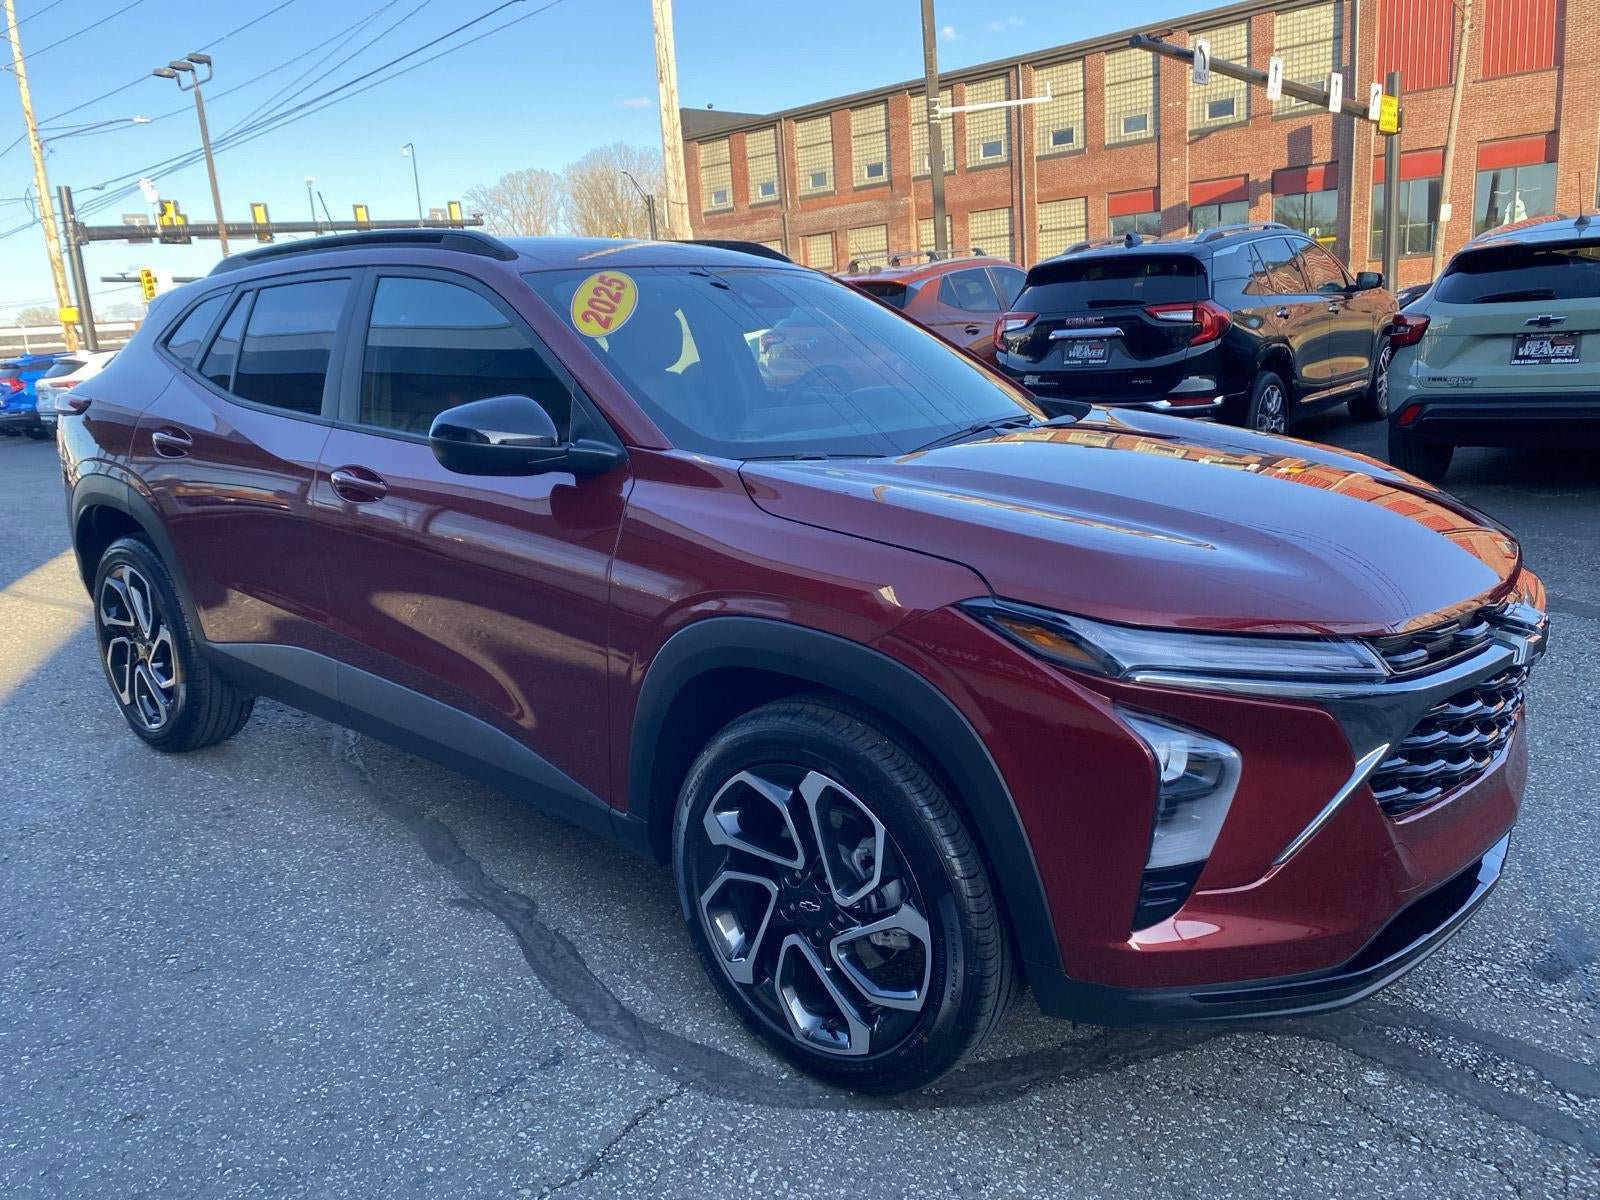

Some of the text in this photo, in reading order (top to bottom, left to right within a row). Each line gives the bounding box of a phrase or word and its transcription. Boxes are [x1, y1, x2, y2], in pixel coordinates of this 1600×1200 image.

[581, 275, 627, 330] 2025
[1066, 316, 1104, 327] GMC
[1518, 345, 1575, 356] WEAVER
